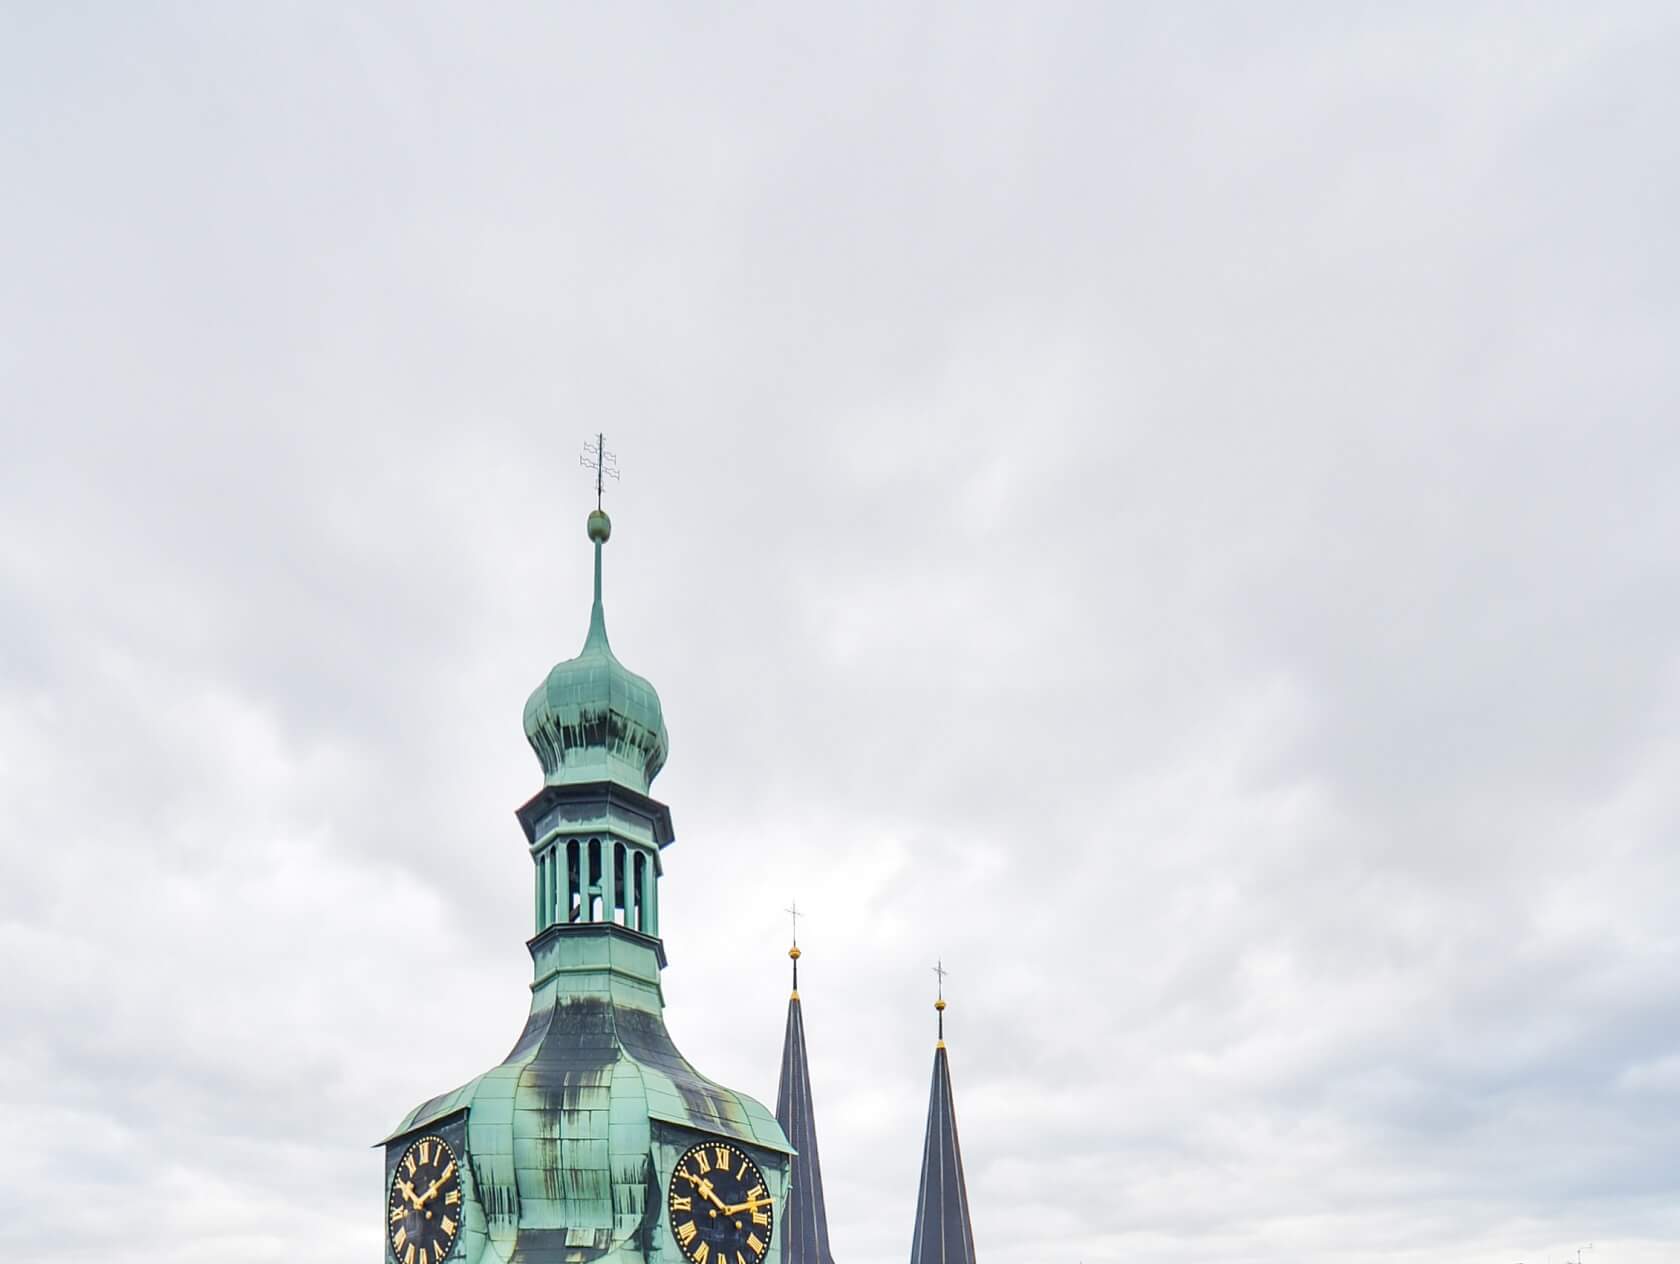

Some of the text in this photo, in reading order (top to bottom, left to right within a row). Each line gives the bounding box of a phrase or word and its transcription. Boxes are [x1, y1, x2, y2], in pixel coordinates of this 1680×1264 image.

[694, 1150, 711, 1175] XI
[715, 1147, 729, 1171] XII
[736, 1162, 747, 1181] I
[747, 1184, 763, 1198] II
[673, 1193, 691, 1211] IX
[678, 1220, 698, 1246] VIII
